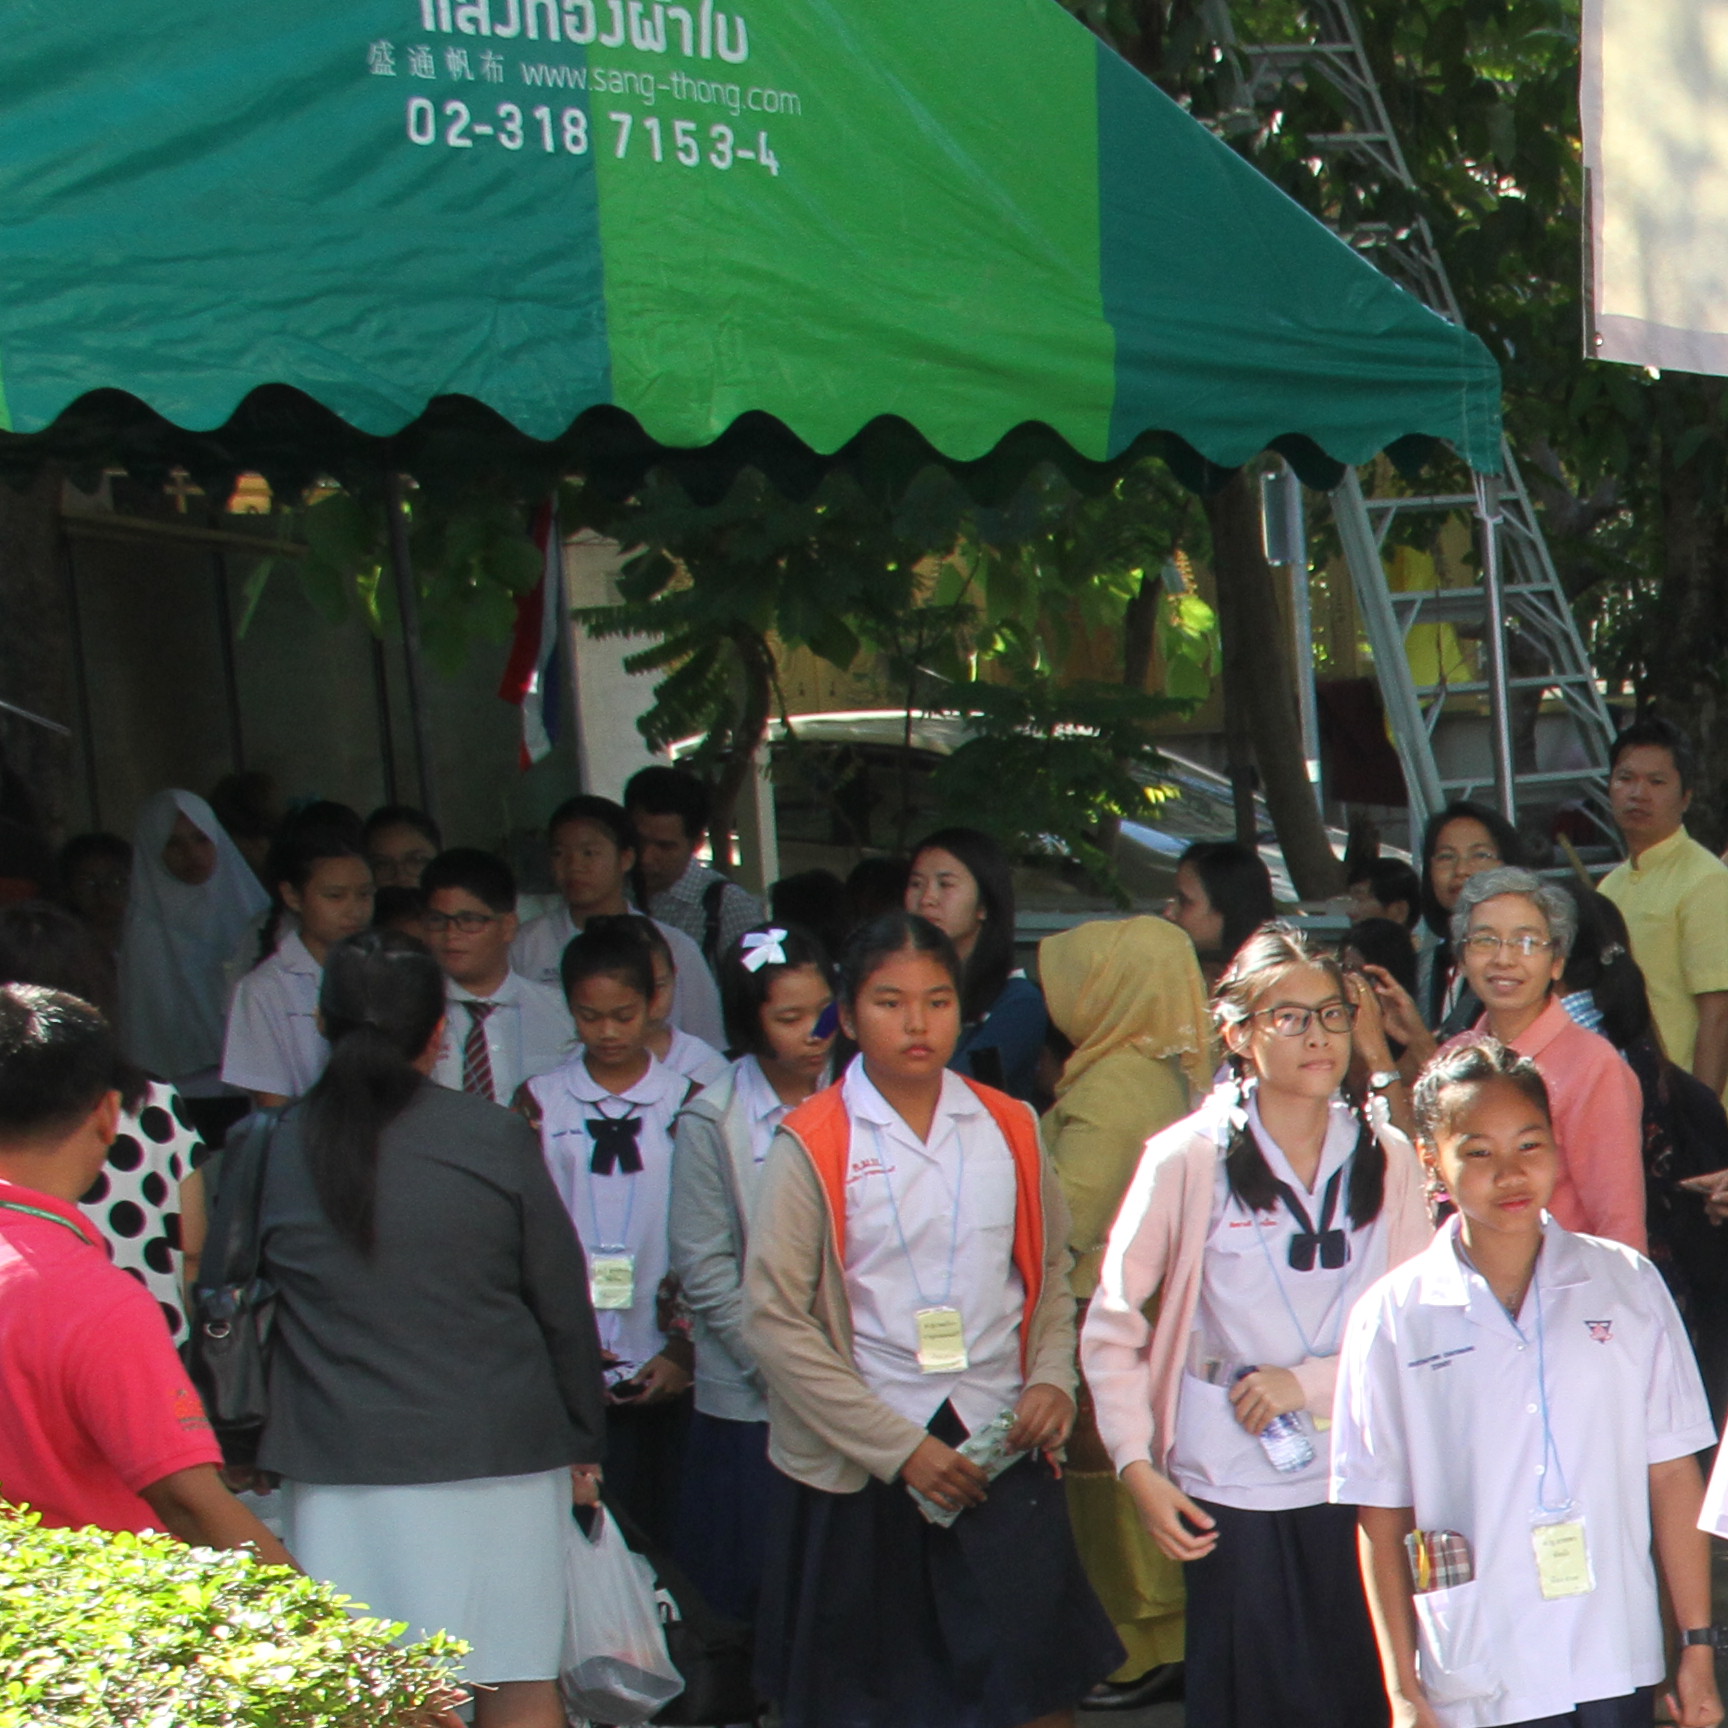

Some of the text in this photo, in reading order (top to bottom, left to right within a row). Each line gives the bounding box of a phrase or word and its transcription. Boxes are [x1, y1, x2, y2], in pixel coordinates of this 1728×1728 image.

[522, 63, 801, 115] www.sang-thong.com
[408, 98, 779, 175] 02-318 7153-4
